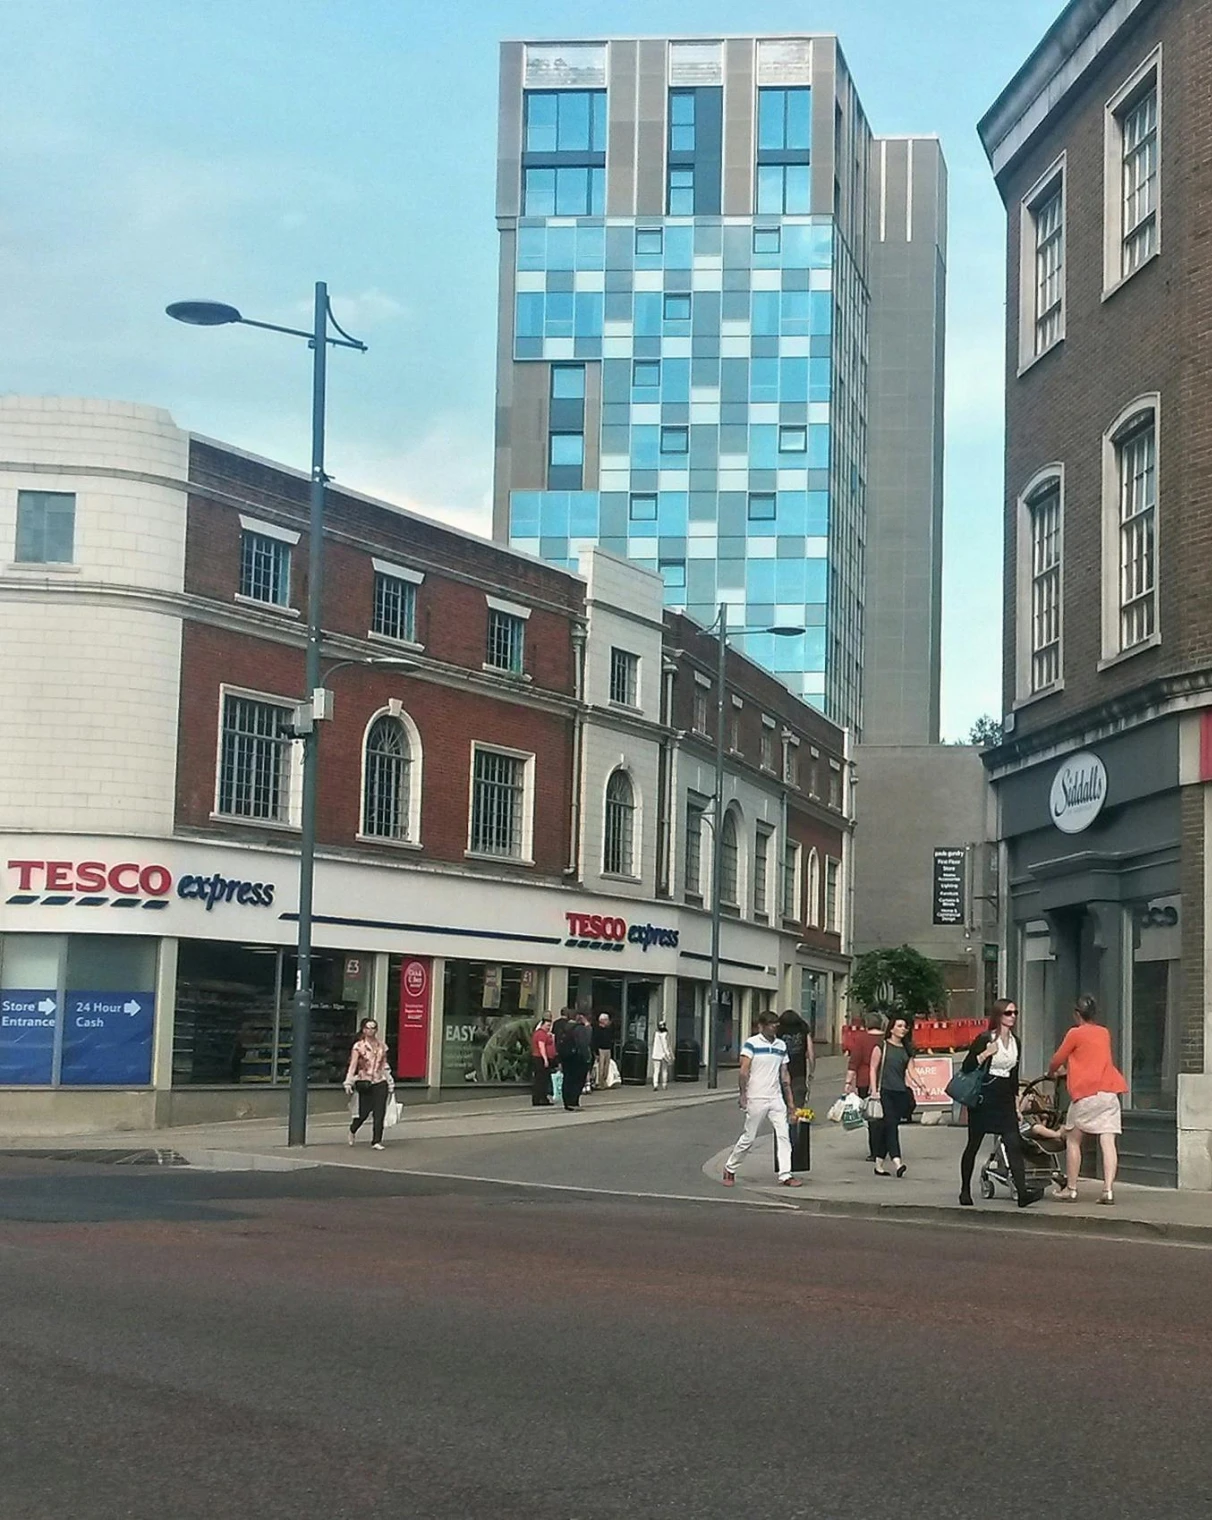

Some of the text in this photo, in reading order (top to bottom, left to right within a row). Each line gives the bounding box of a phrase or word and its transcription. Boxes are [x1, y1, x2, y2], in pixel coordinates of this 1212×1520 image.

[1054, 764, 1102, 817] Siddalls
[8, 860, 275, 911] TESCO express
[565, 912, 679, 952] TESCO express
[2, 1001, 35, 1012] Store
[76, 1002, 122, 1012] 24 Hour
[1, 1016, 56, 1027] Entrance
[76, 1017, 104, 1028] Cash
[446, 1025, 477, 1042] EASY
